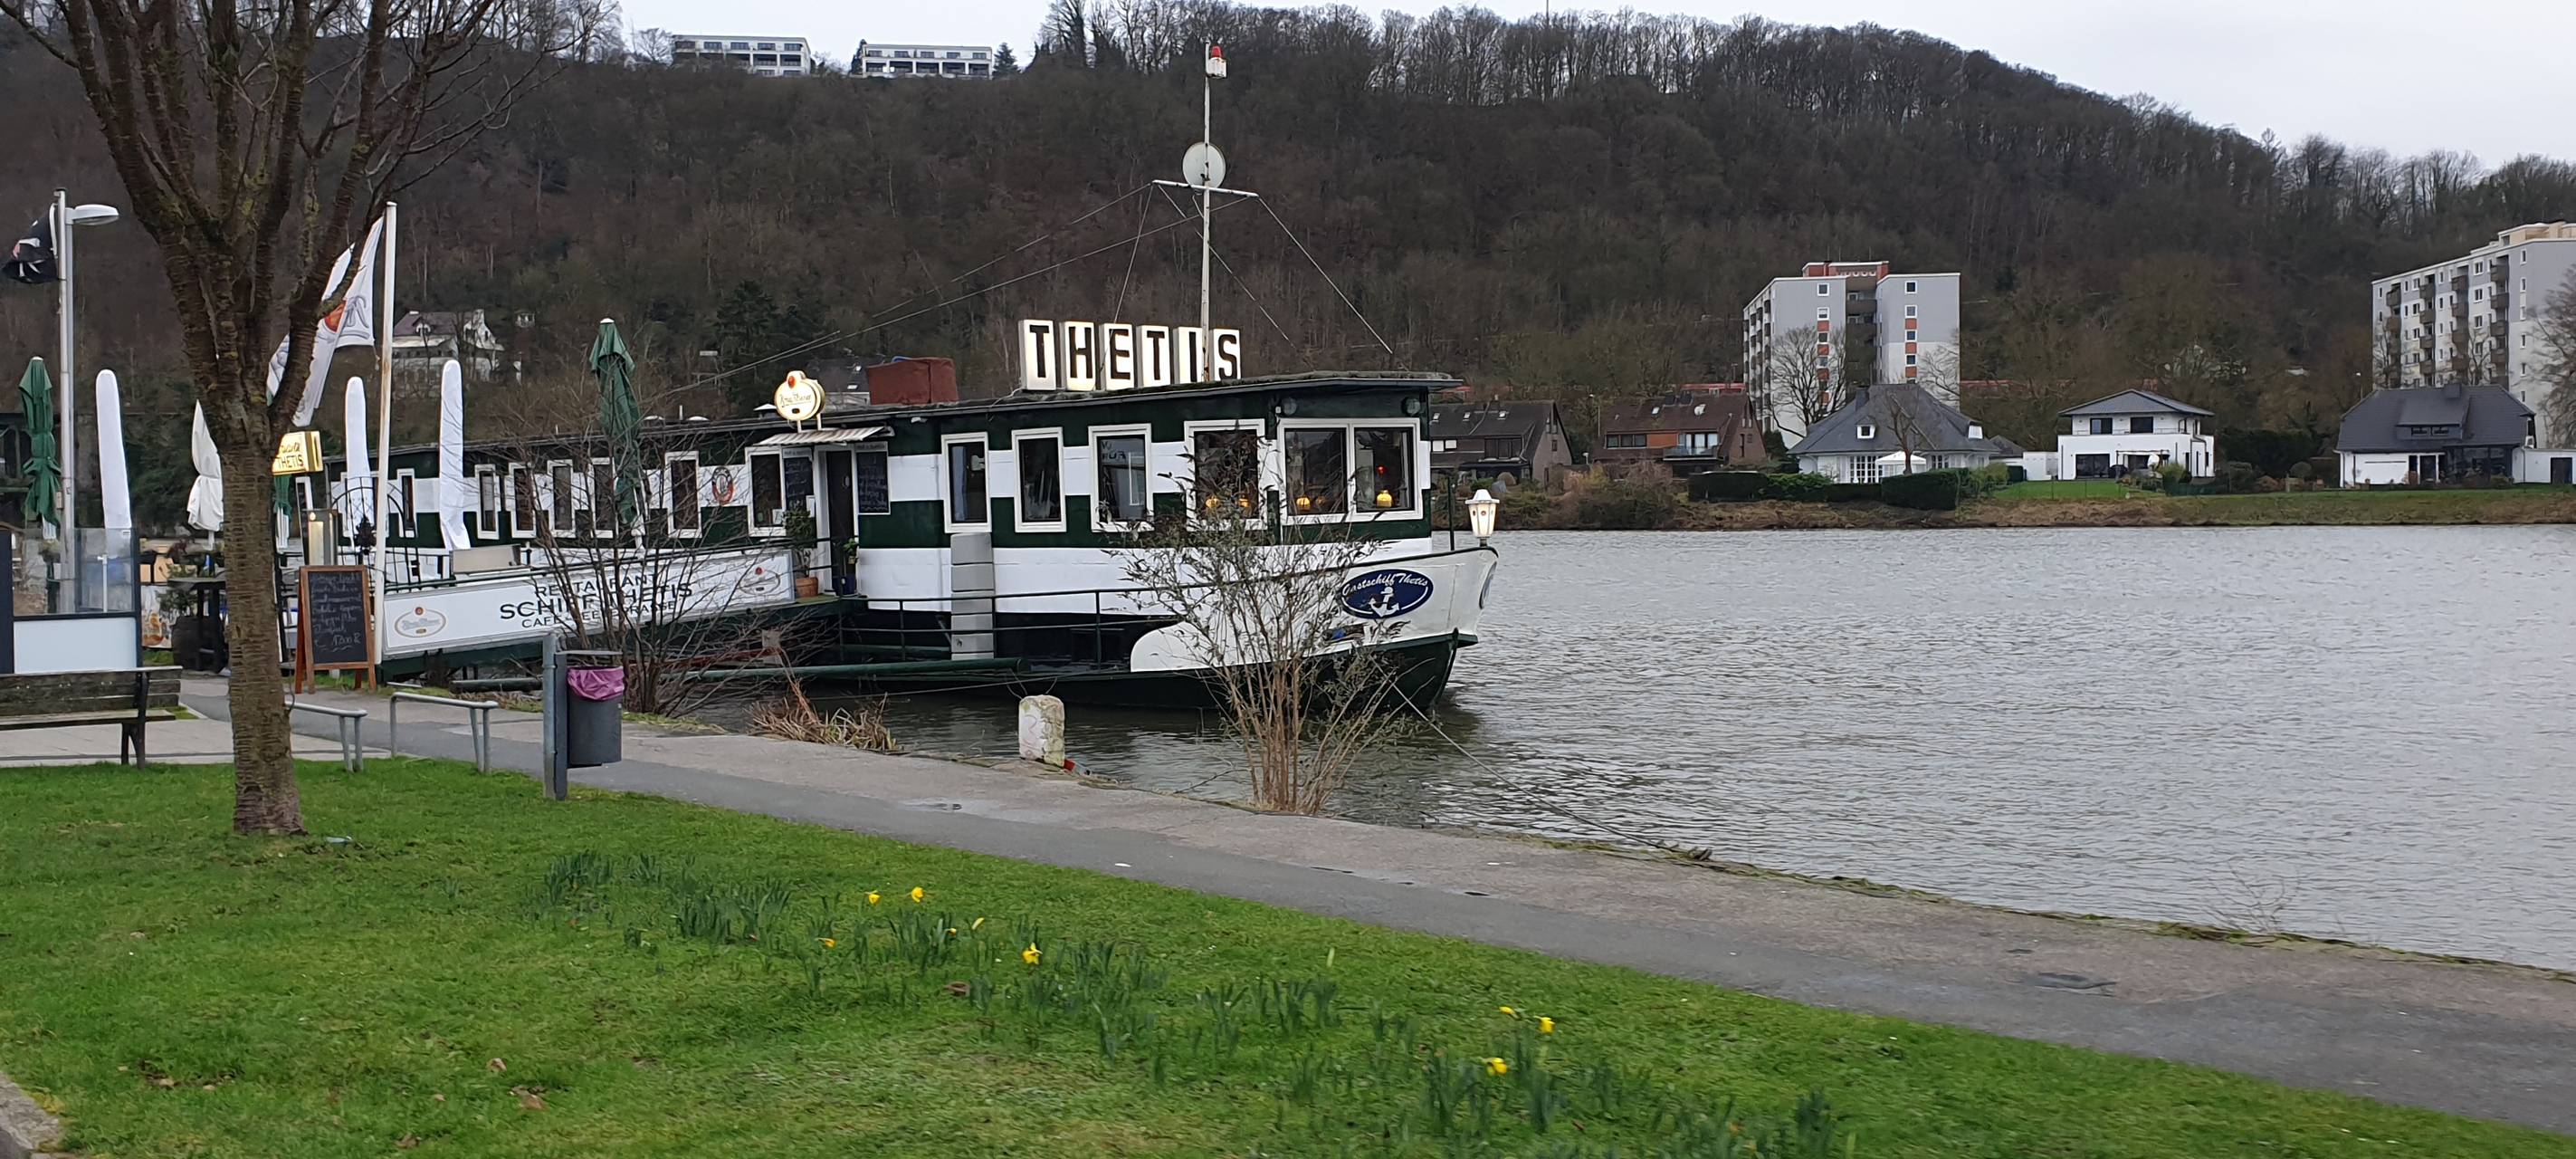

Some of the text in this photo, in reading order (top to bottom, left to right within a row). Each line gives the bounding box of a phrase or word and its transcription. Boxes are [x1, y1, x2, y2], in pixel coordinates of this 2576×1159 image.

[1029, 323, 1237, 383] THETIS
[536, 573, 659, 597] RETARAN
[1395, 572, 1429, 587] Thetis
[500, 591, 598, 620] SCHIF
